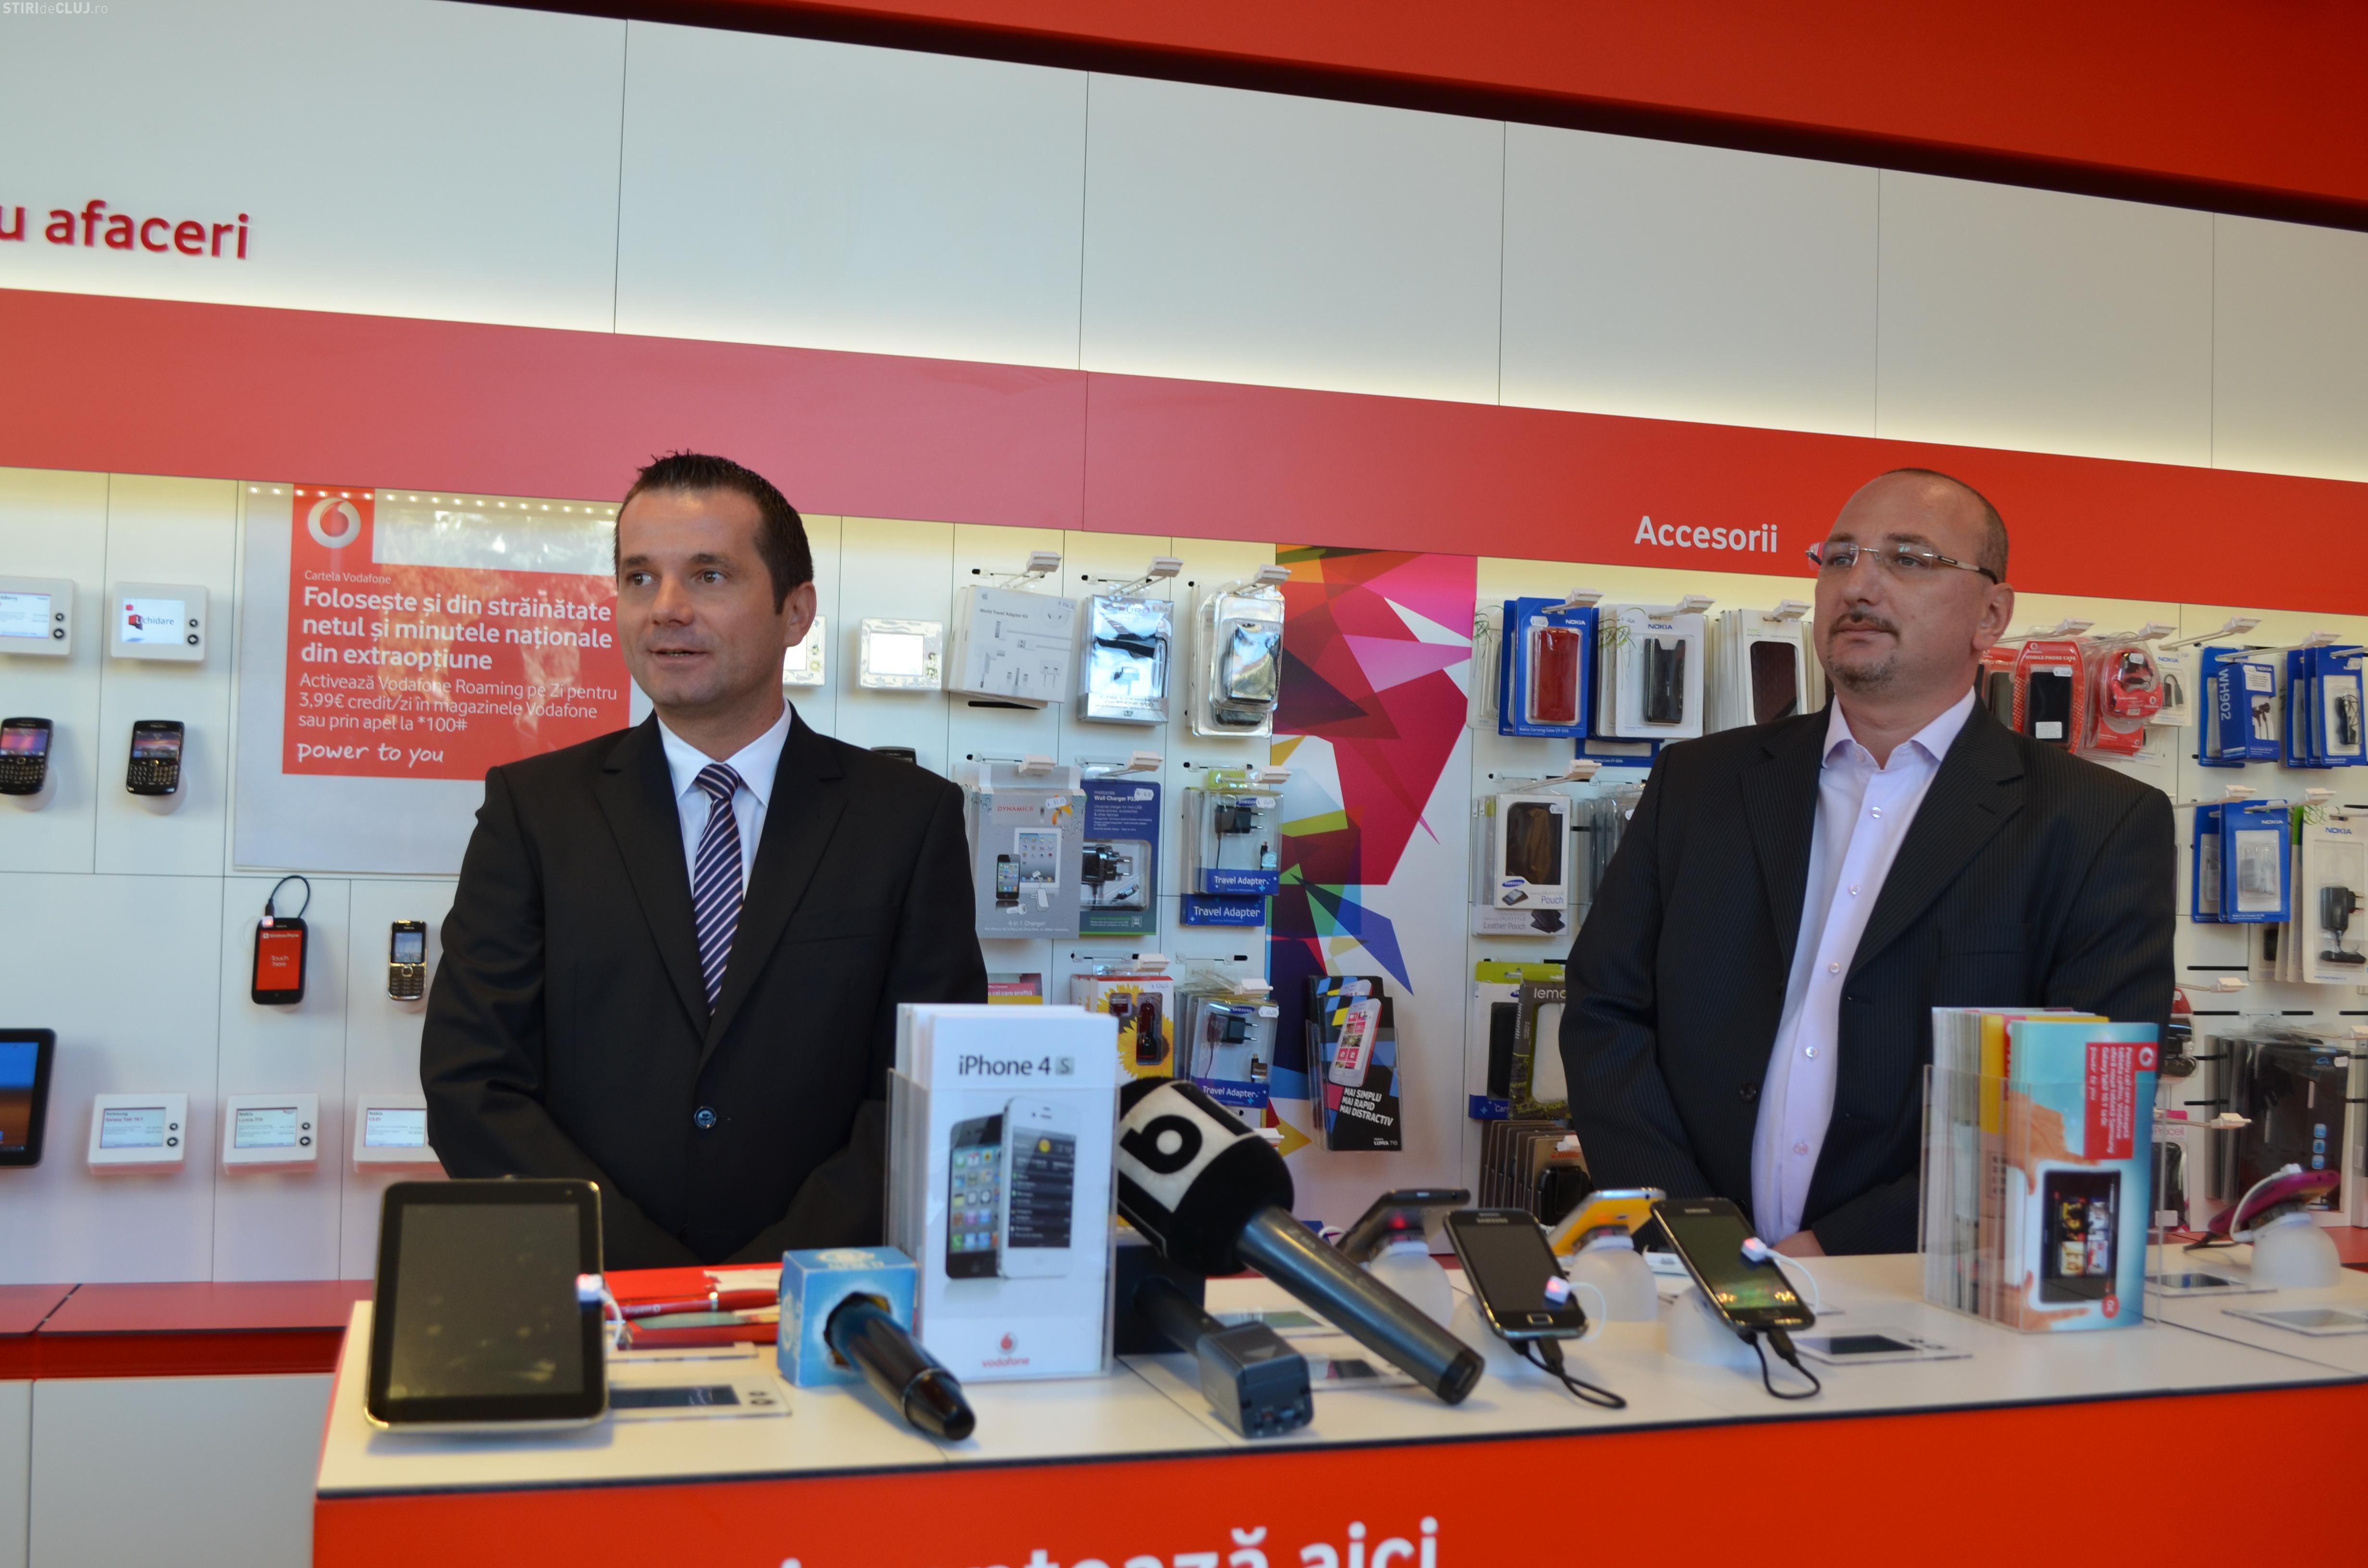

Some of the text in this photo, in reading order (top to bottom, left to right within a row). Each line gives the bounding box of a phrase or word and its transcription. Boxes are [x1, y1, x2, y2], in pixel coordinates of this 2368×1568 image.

[45, 198, 250, 260] afaceri
[1634, 515, 1777, 553] Accesorii
[305, 570, 391, 585] Cartela Vodafone
[304, 586, 611, 621] Folosește și din străinătate
[303, 616, 613, 650] netul și minutele naționale
[301, 642, 493, 673] din extraopțiune
[299, 672, 617, 701] Activează Vodafone Roaming pe Zi pentru
[2219, 668, 2232, 721] WH902
[299, 691, 598, 719] 3,99€ credit/zi în magazinele Vodafone
[298, 714, 325, 727] sau
[329, 714, 359, 731] prin
[363, 715, 396, 733] apel
[400, 716, 414, 731] la
[296, 742, 444, 769] power to you
[1214, 875, 1267, 887] Travel Adapter
[1541, 895, 1564, 904] Pouch
[1193, 906, 1261, 919] Travel Adapter
[959, 1054, 1033, 1076] iPhone
[1037, 1055, 1051, 1076] 4
[1202, 1085, 1256, 1099] Travel Adapter
[1341, 1095, 1375, 1111] MAI RAPID
[1344, 1087, 1382, 1102] MAI SIMPLU
[1339, 1104, 1394, 1127] MAI DISTRACTIV
[982, 1356, 1030, 1369] vodafone
